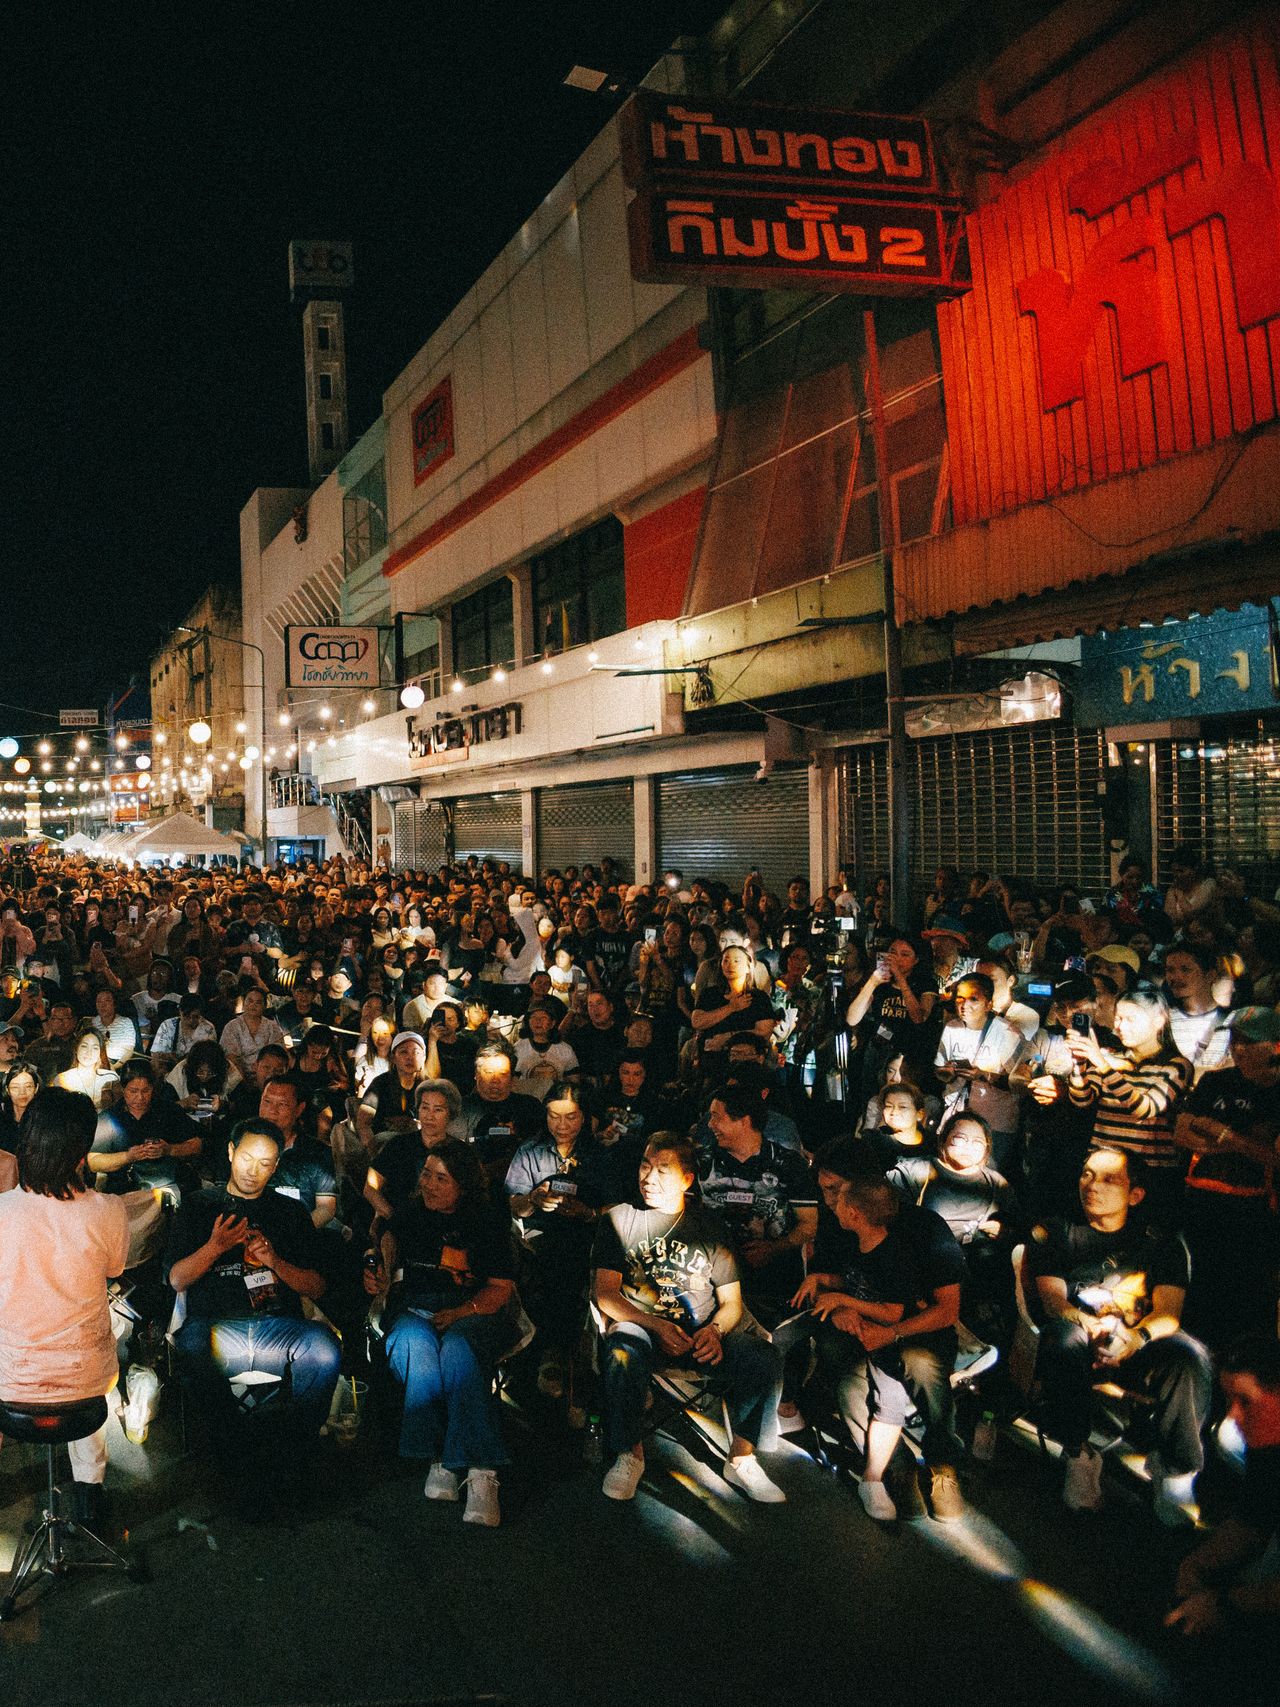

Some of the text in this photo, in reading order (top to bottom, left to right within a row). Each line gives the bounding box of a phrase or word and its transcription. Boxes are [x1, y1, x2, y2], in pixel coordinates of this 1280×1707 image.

[650, 104, 922, 178] ห้างทอง
[666, 199, 927, 267] กิมปั้ง 2
[302, 663, 369, 681] โชคชัยวิทยา
[553, 1183, 577, 1195] GUEST
[728, 1193, 752, 1201] GUEST
[253, 1275, 266, 1285] VIP
